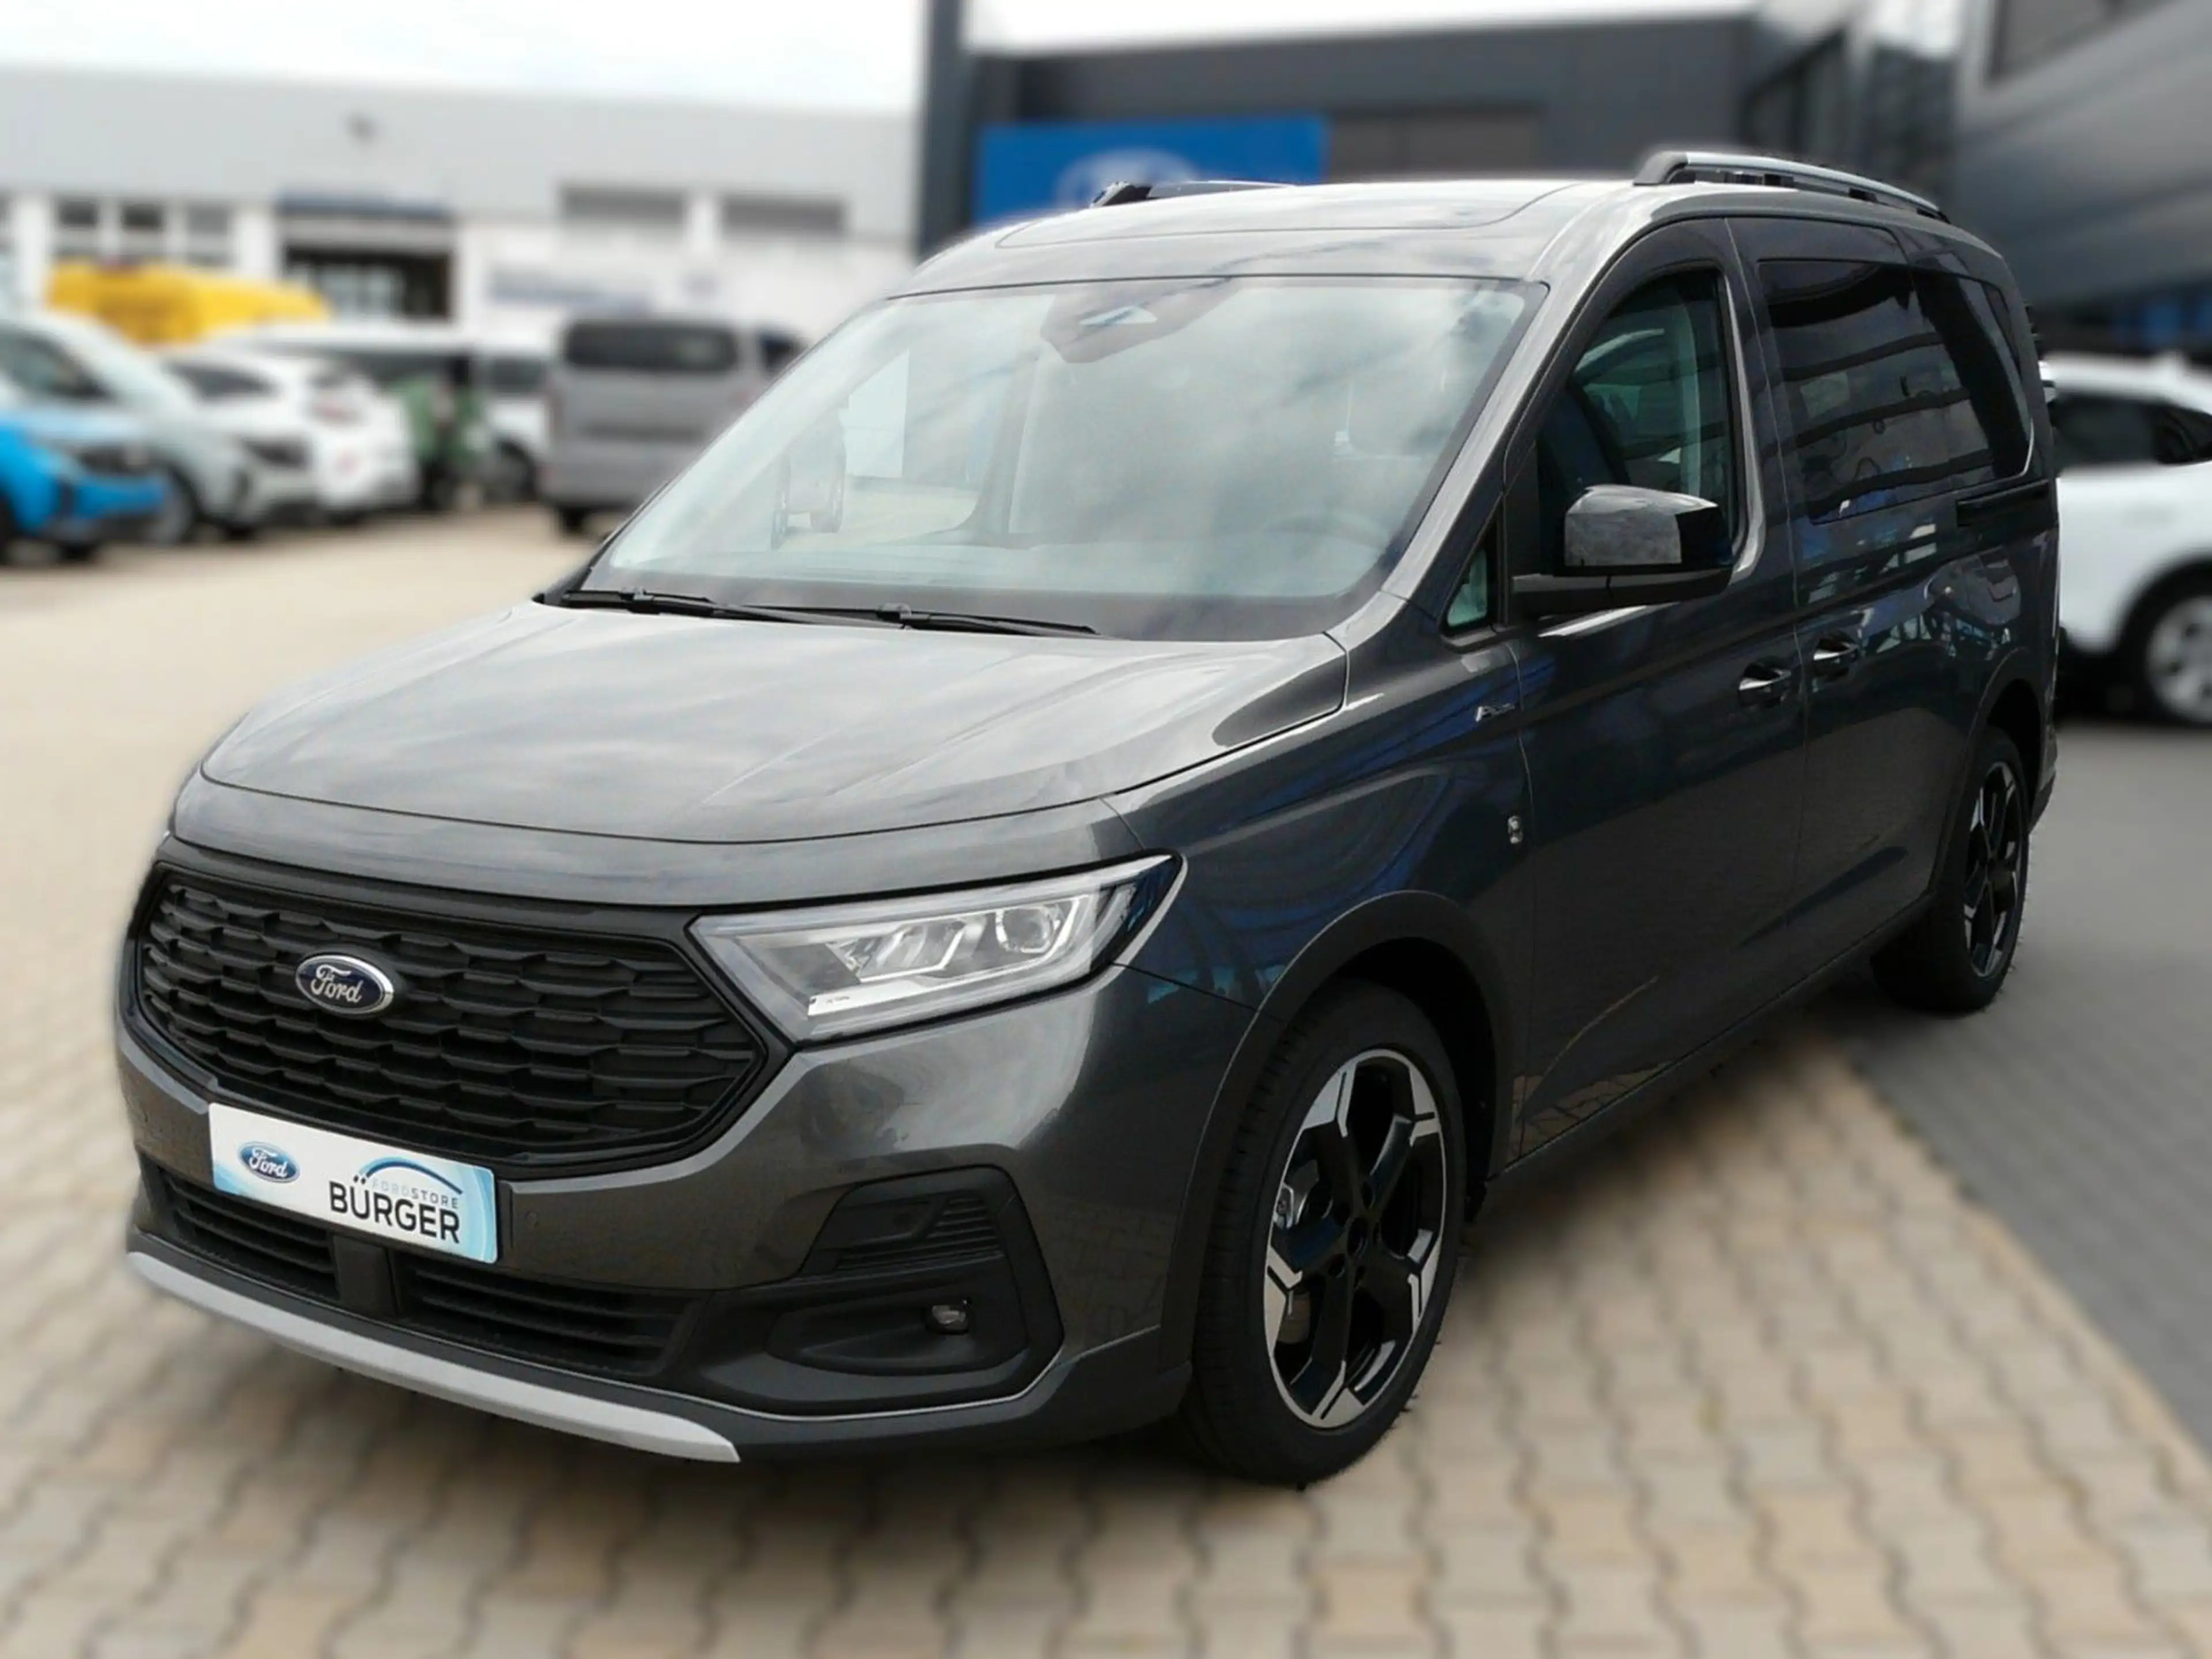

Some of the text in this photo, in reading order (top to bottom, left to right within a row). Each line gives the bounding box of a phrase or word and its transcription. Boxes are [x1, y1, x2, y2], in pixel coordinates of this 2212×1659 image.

[310, 964, 364, 1003] Ford
[249, 1147, 288, 1177] Ford
[329, 1175, 460, 1244] BÜRGER
